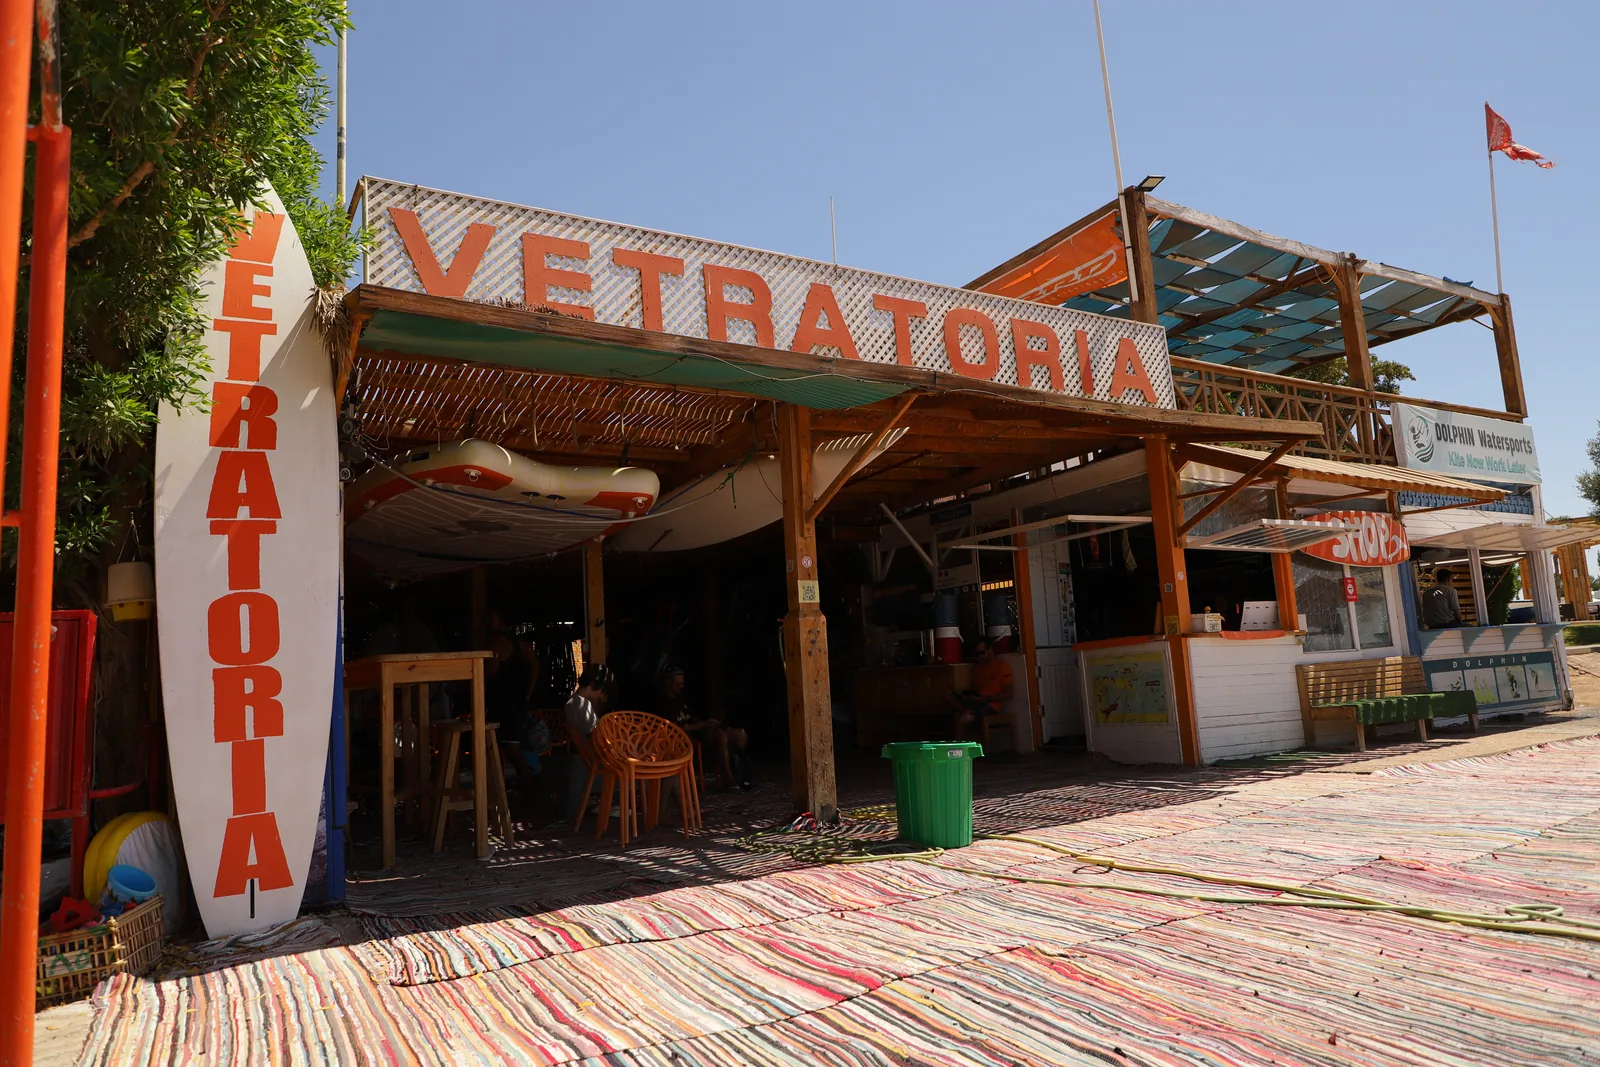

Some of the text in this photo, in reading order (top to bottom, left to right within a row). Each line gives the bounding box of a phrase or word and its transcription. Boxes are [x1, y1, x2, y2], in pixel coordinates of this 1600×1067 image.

[387, 206, 1158, 403] VETRATORIA
[1434, 422, 1533, 456] DOLPHIN Watersports
[1448, 450, 1527, 475] Kite Now Work Later
[206, 210, 294, 898] VETRATORIA
[1329, 515, 1390, 562] SHOP
[1452, 655, 1527, 668] DOLPHIN
